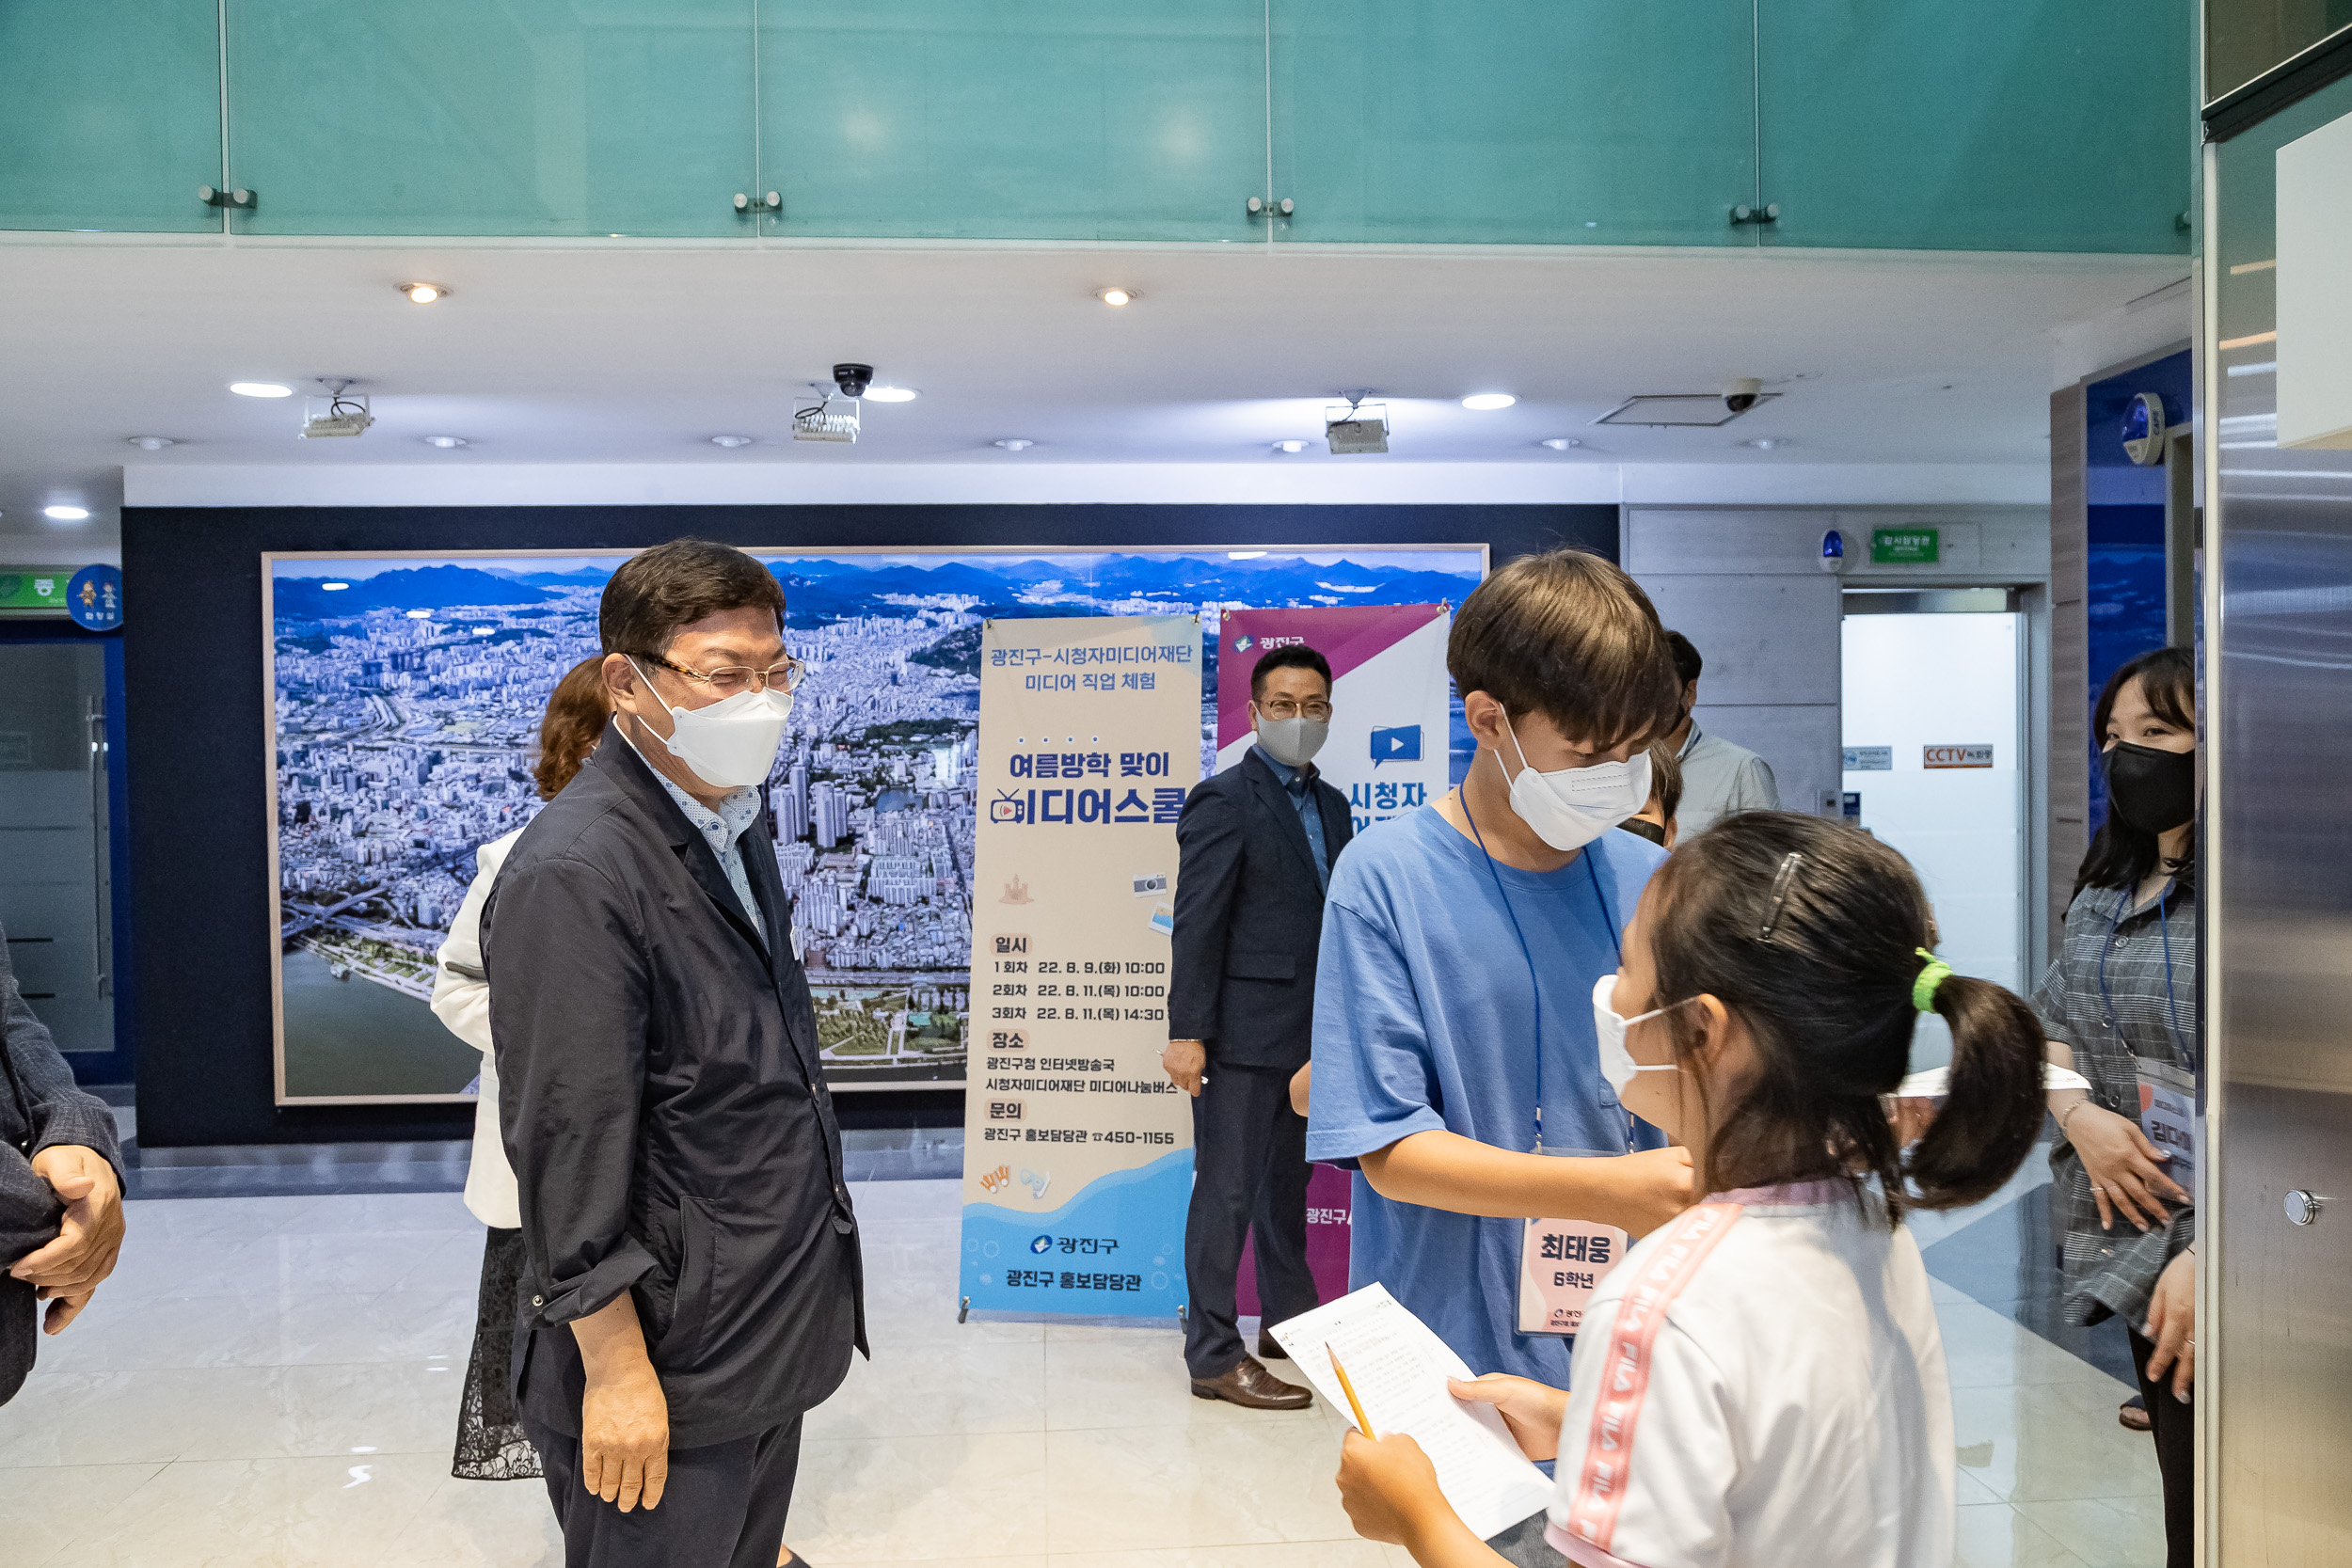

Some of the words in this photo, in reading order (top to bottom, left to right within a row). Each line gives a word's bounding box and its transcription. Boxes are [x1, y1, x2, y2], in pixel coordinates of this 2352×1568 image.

[991, 644, 1193, 666] 광진구-시청자미디어재단
[1025, 674, 1075, 691] 미디어
[1082, 673, 1116, 690] 직업
[1120, 672, 1155, 690] 체험
[1926, 749, 1966, 762] CCTV
[1009, 752, 1112, 779] 여름방학
[1120, 752, 1169, 778] 맞이
[1351, 782, 1427, 809] 시청자
[995, 937, 1027, 954] 일시
[1125, 962, 1166, 974] 10:00
[993, 984, 1027, 997] 2회차
[1124, 986, 1166, 998] 10:00
[992, 1007, 1027, 1020] 3회차
[1124, 1008, 1165, 1021] 14:30
[993, 1032, 1025, 1049] 장소
[986, 1057, 1036, 1070] 광진구청
[1040, 1058, 1115, 1072] 인터넷방송국
[986, 1078, 1086, 1093] 시청자미디어재단
[1089, 1080, 1179, 1094] 미디어나눔버스
[990, 1102, 1022, 1119] 문의
[984, 1128, 1022, 1142] 광진구
[1025, 1129, 1088, 1143] 홍보담당관
[1306, 1208, 1347, 1225] 광진구
[1057, 1237, 1120, 1255] 광진구
[1540, 1233, 1611, 1264] 최태웅
[1007, 1270, 1055, 1288] 광진구
[1060, 1272, 1142, 1291] 홍보담당관
[1554, 1272, 1594, 1290] 6학년
[1613, 1341, 1638, 1392] FILA
